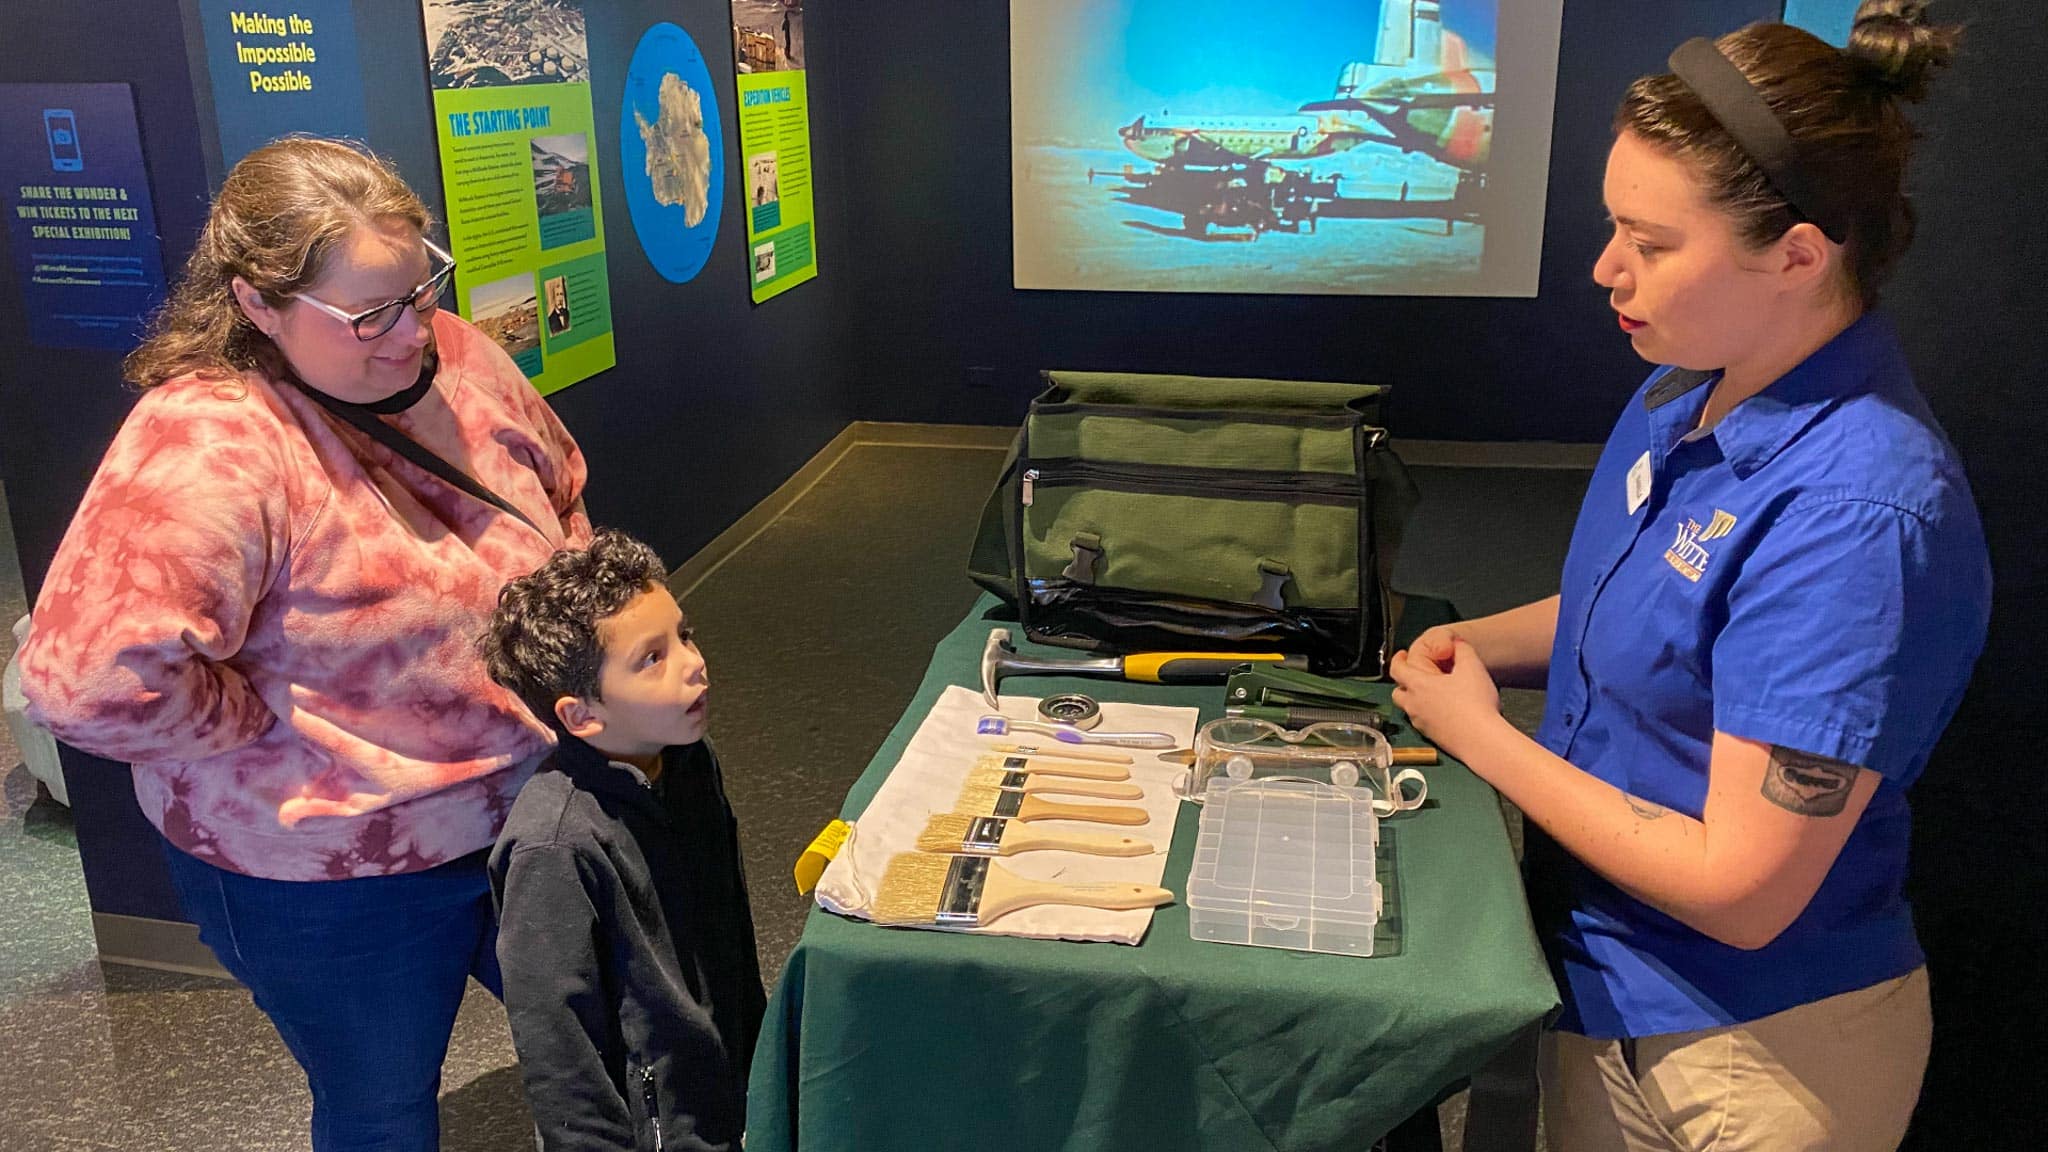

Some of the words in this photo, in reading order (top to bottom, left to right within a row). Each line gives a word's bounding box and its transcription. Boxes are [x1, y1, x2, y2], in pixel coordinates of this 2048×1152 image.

[230, 11, 287, 37] Making
[289, 13, 313, 34] the
[236, 41, 316, 65] Impossible
[249, 70, 312, 92] Possible
[448, 112, 471, 137] THE
[472, 108, 521, 135] STARTING
[522, 105, 551, 130] POINT
[20, 186, 53, 199] SHARE
[53, 187, 73, 200] THE
[73, 187, 118, 201] WONDER
[119, 188, 128, 201] &
[16, 206, 39, 219] WIN
[39, 206, 77, 219] TICKETS
[78, 207, 91, 220] TO
[92, 207, 112, 220] THE
[113, 208, 139, 221] NEXT
[31, 225, 71, 239] SPECIAL
[71, 227, 131, 240] EXHIBITION!
[1687, 518, 1702, 534] THE
